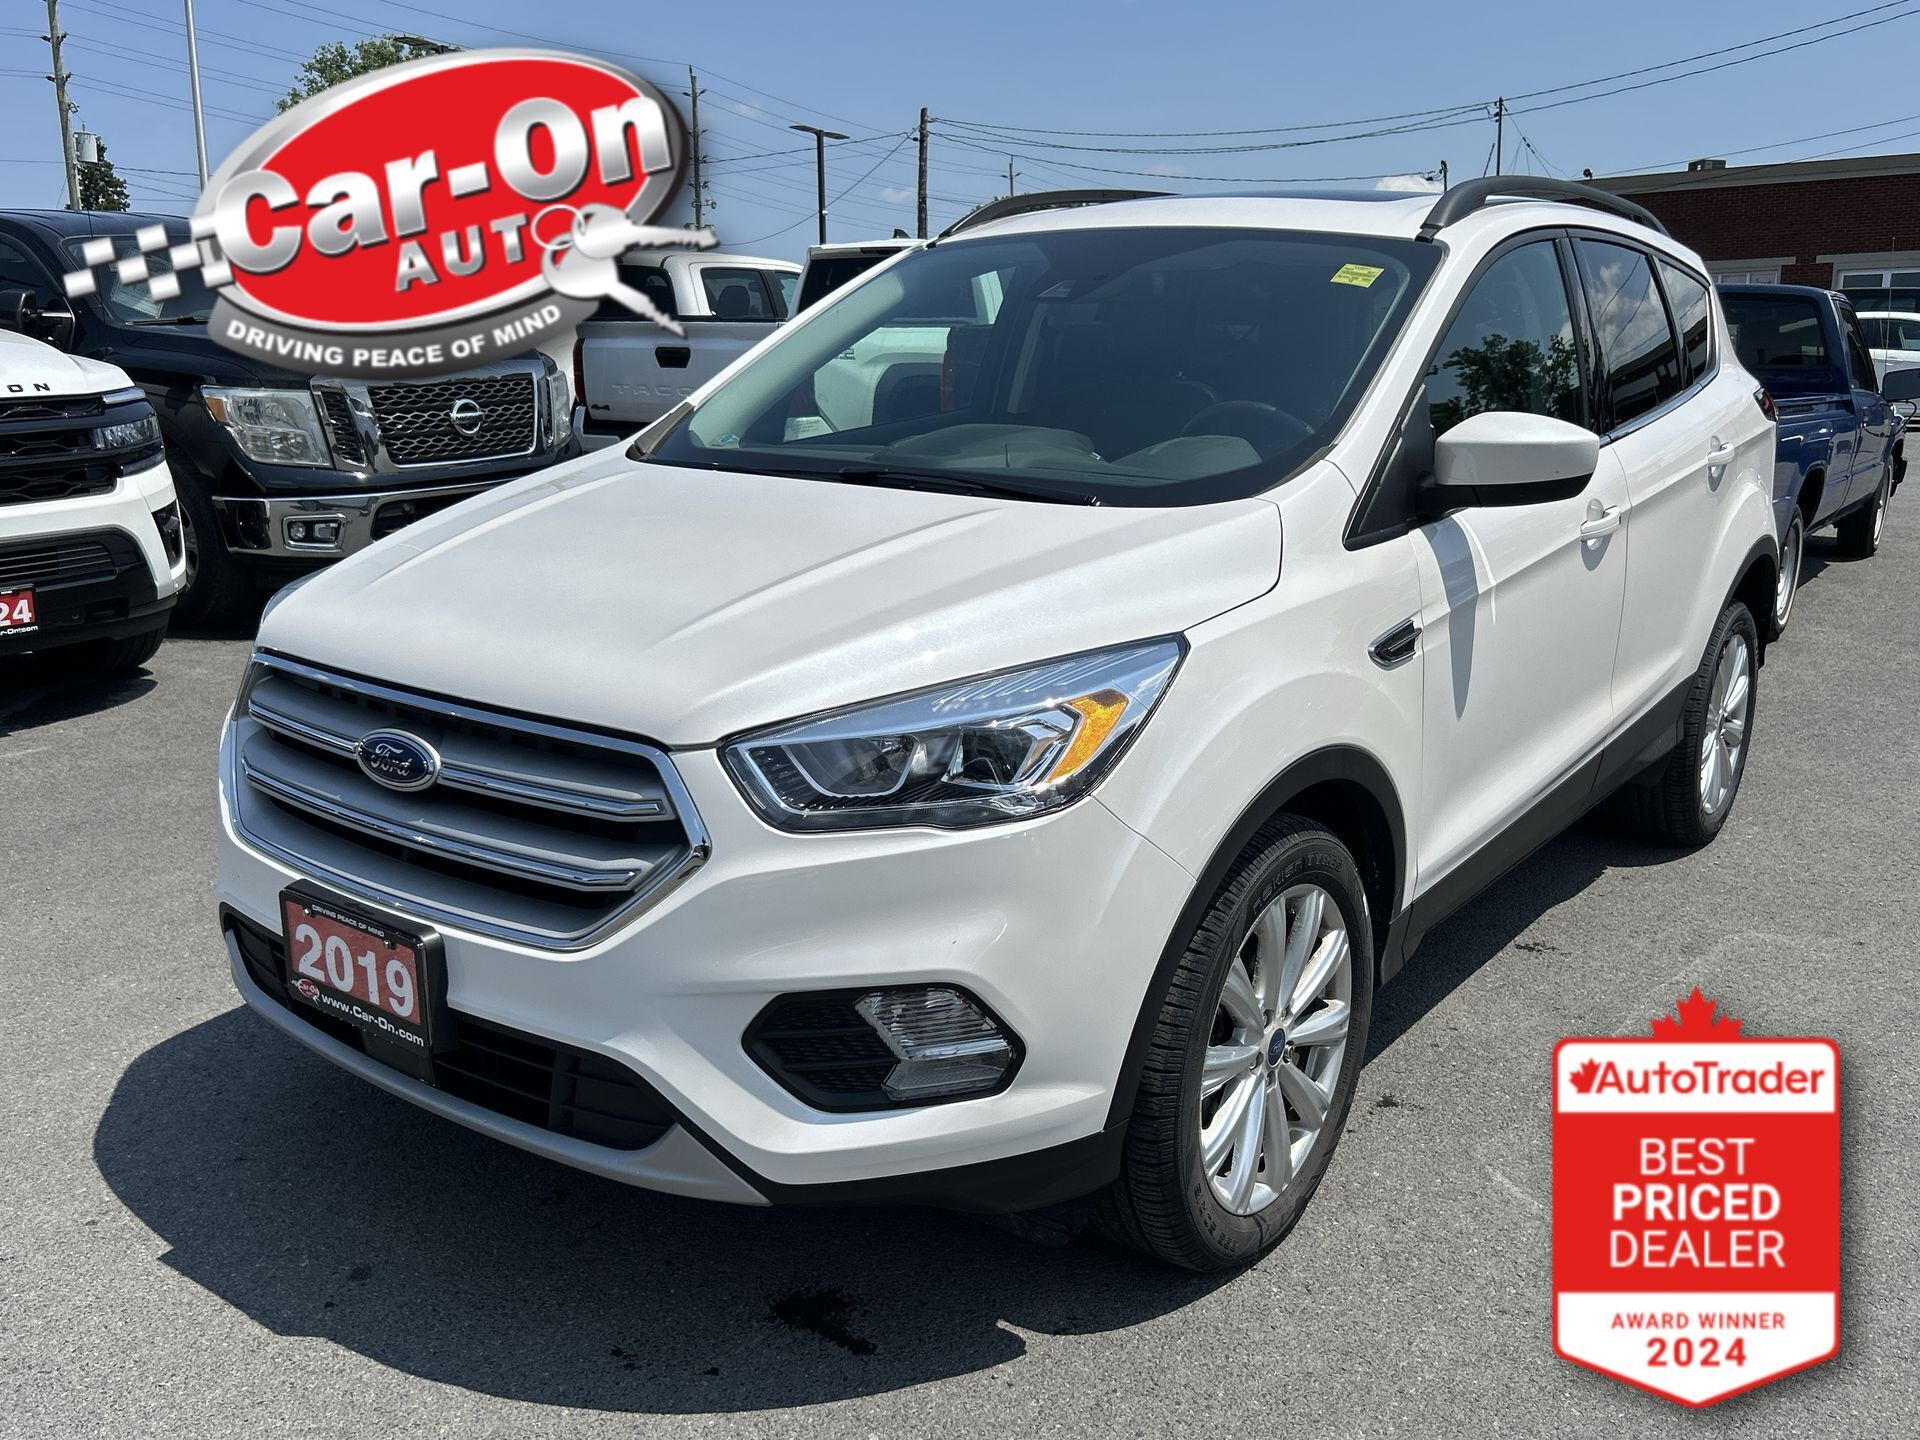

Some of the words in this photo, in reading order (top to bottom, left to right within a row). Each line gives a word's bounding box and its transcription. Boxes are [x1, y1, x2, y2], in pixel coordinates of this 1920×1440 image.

[371, 743, 413, 776] Ford
[337, 914, 357, 927] PEACE
[358, 922, 367, 930] OF
[295, 923, 414, 1018] 2019
[321, 994, 425, 1047] www.Car-On.com
